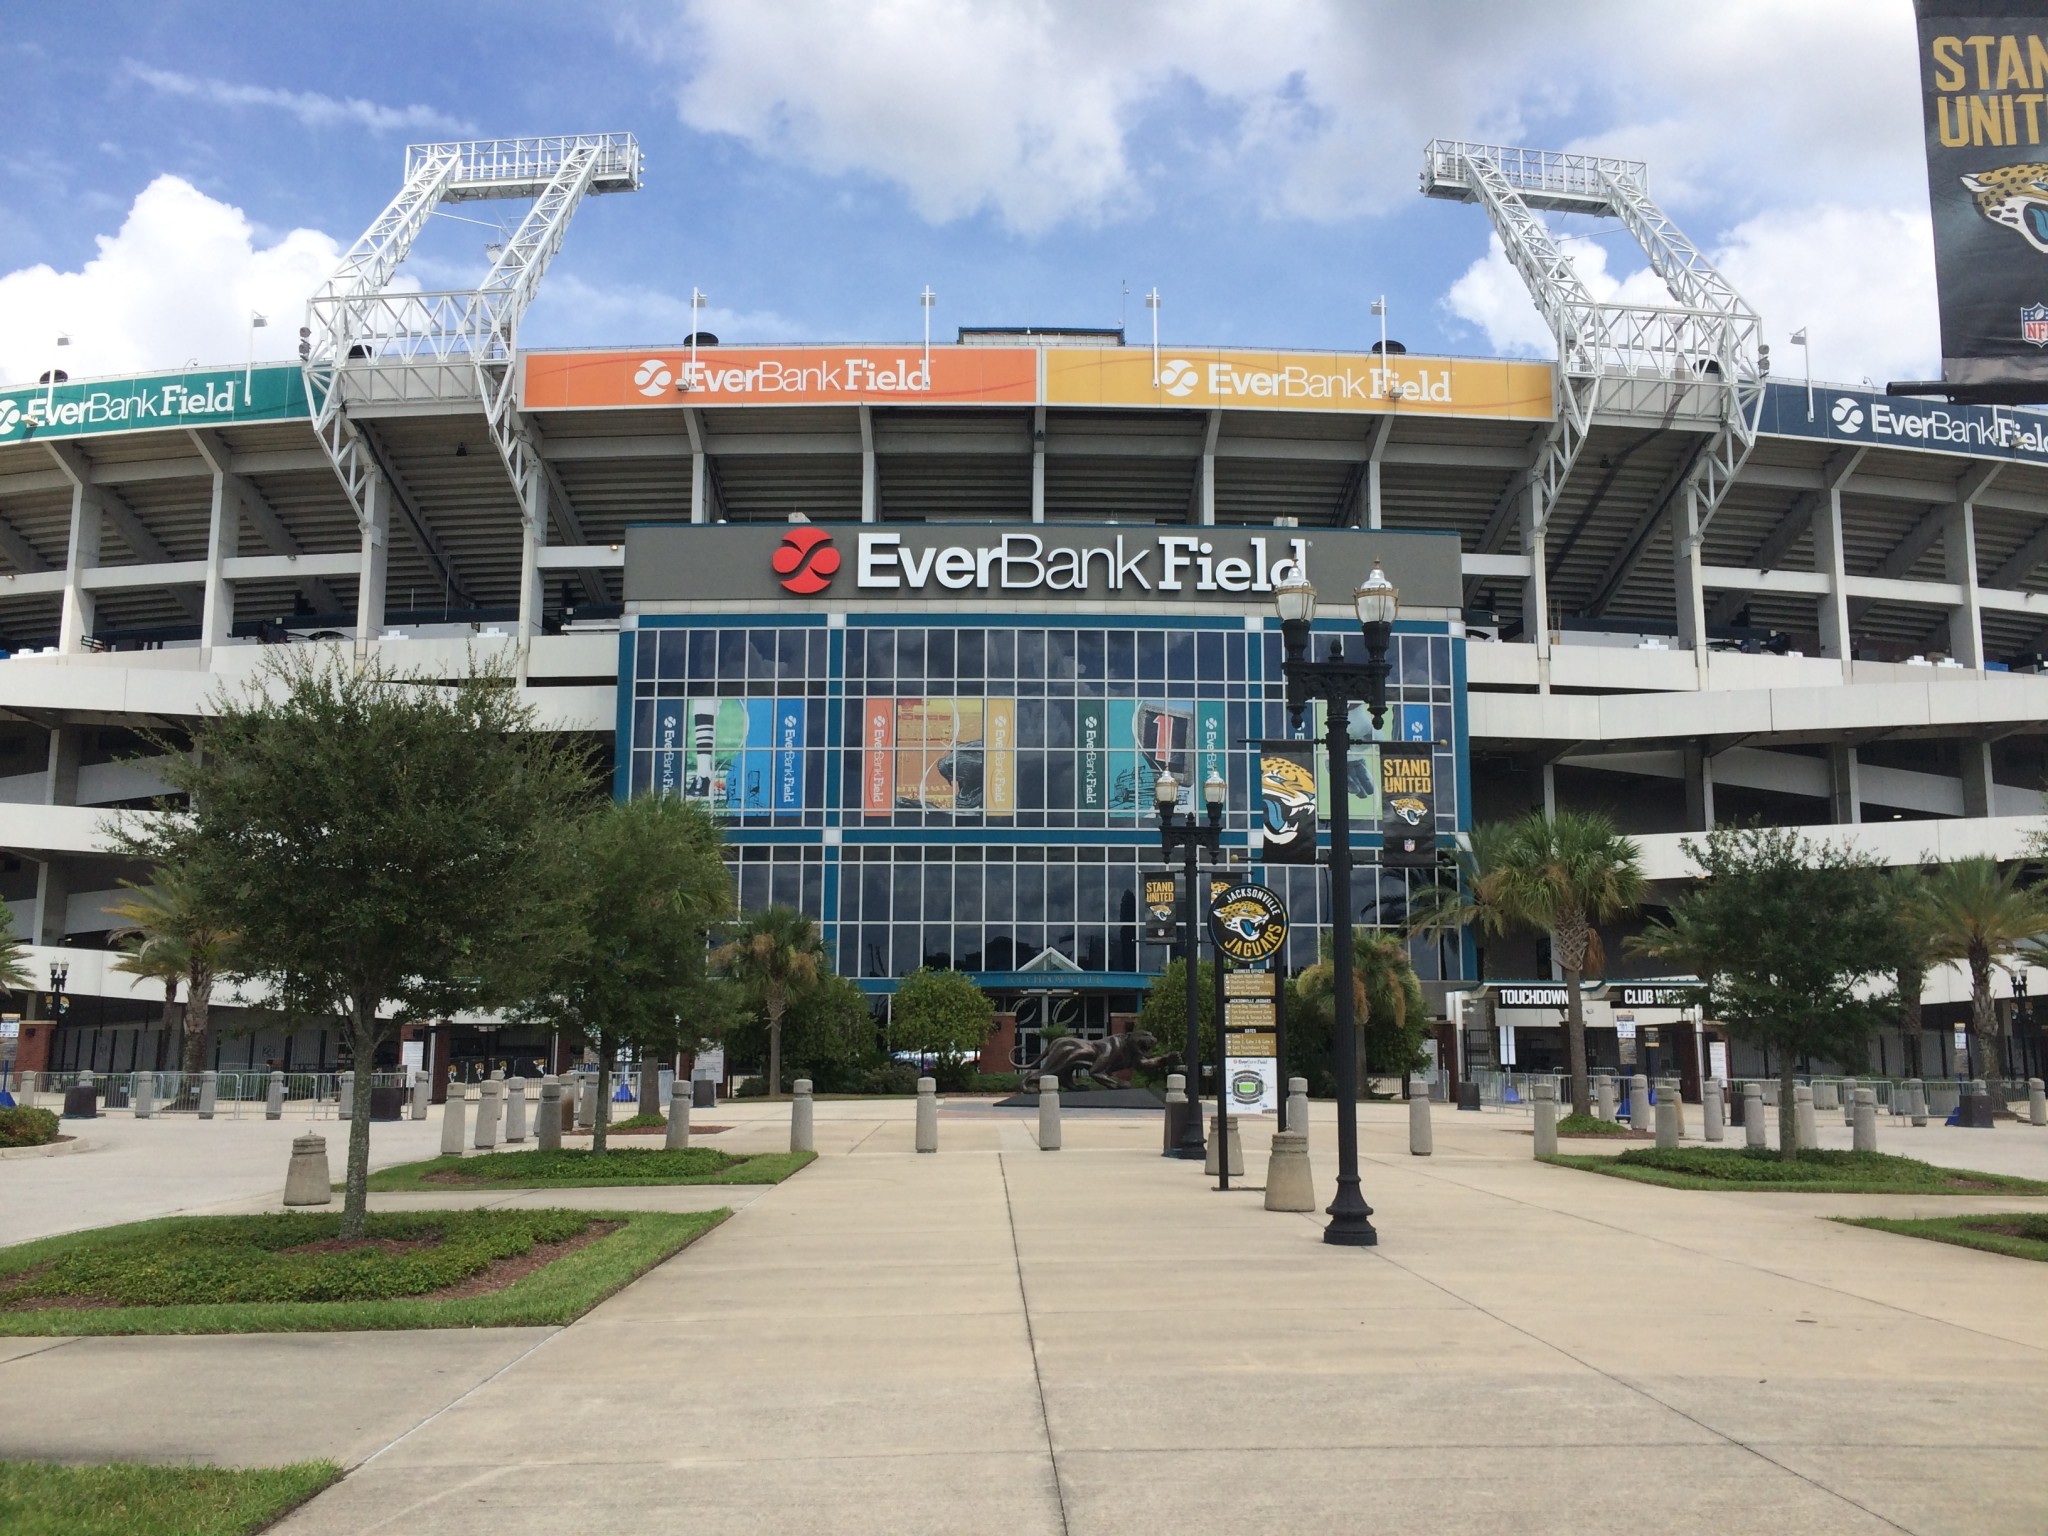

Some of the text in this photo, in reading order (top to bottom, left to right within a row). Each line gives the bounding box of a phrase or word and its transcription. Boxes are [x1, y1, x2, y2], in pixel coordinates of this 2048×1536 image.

[1932, 34, 2048, 91] STAN
[1937, 93, 2048, 147] UNIT
[2026, 322, 2048, 339] NF
[682, 359, 930, 392] EverBank Field
[1208, 363, 1452, 402] EverBank Field
[27, 381, 236, 427] EverBank Field
[1871, 404, 2048, 452] EverBank Fiel
[857, 533, 1307, 592] EverBank Field
[1383, 759, 1431, 776] STAND
[662, 778, 674, 801] Fie
[784, 777, 795, 803] Field
[1086, 778, 1097, 804] Field
[1384, 777, 1432, 794] UNITED
[1146, 882, 1174, 892] STAND
[1146, 892, 1174, 902] UNITED
[1226, 888, 1281, 916] JACKSONVILLE
[1224, 923, 1282, 957] JAGUARS
[1500, 989, 1569, 1005] TOUCHDOWN
[1624, 989, 1654, 1005] CLUB
